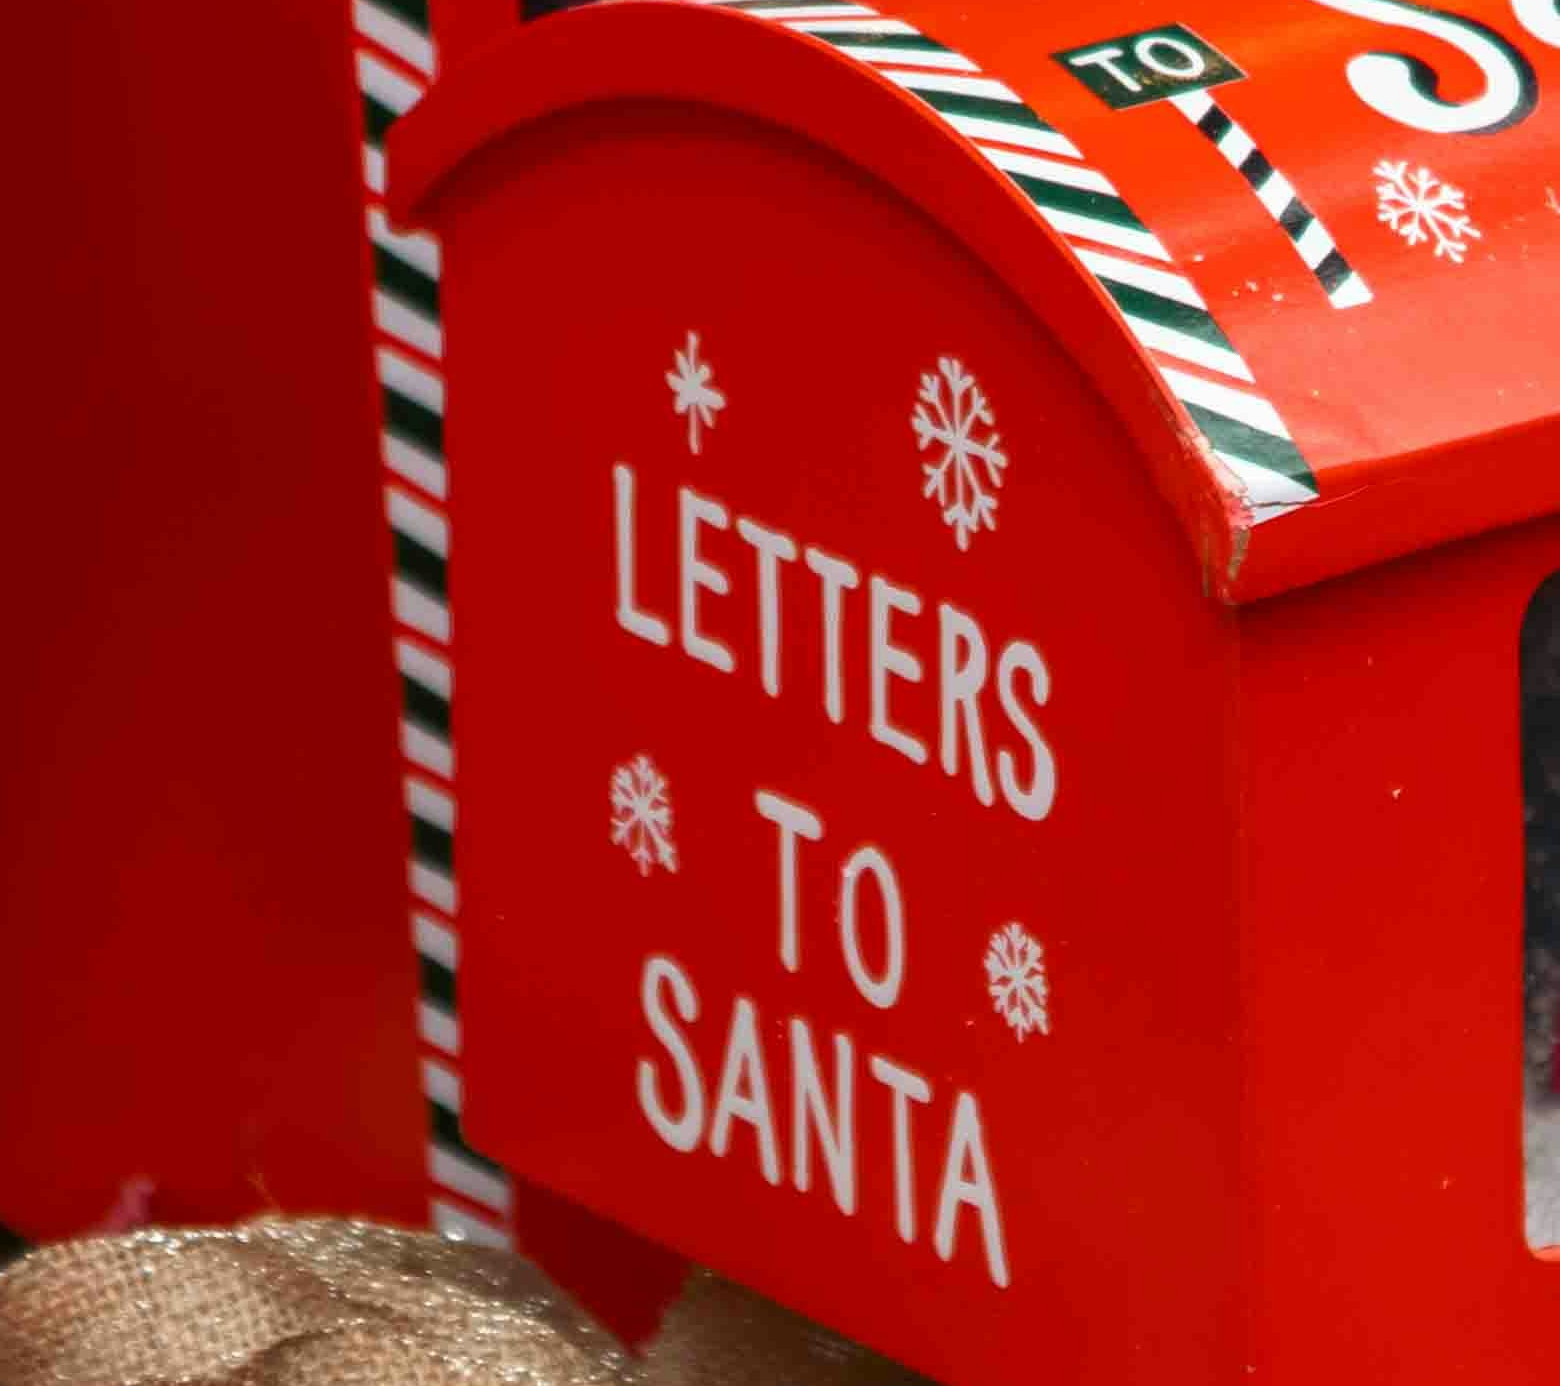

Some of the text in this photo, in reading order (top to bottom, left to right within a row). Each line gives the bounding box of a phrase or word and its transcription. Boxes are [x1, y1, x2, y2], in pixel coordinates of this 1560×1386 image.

[1068, 37, 1206, 92] TO
[614, 464, 1057, 821] LETTERS
[754, 789, 905, 1009] TO
[639, 956, 1010, 1289] SANTA
